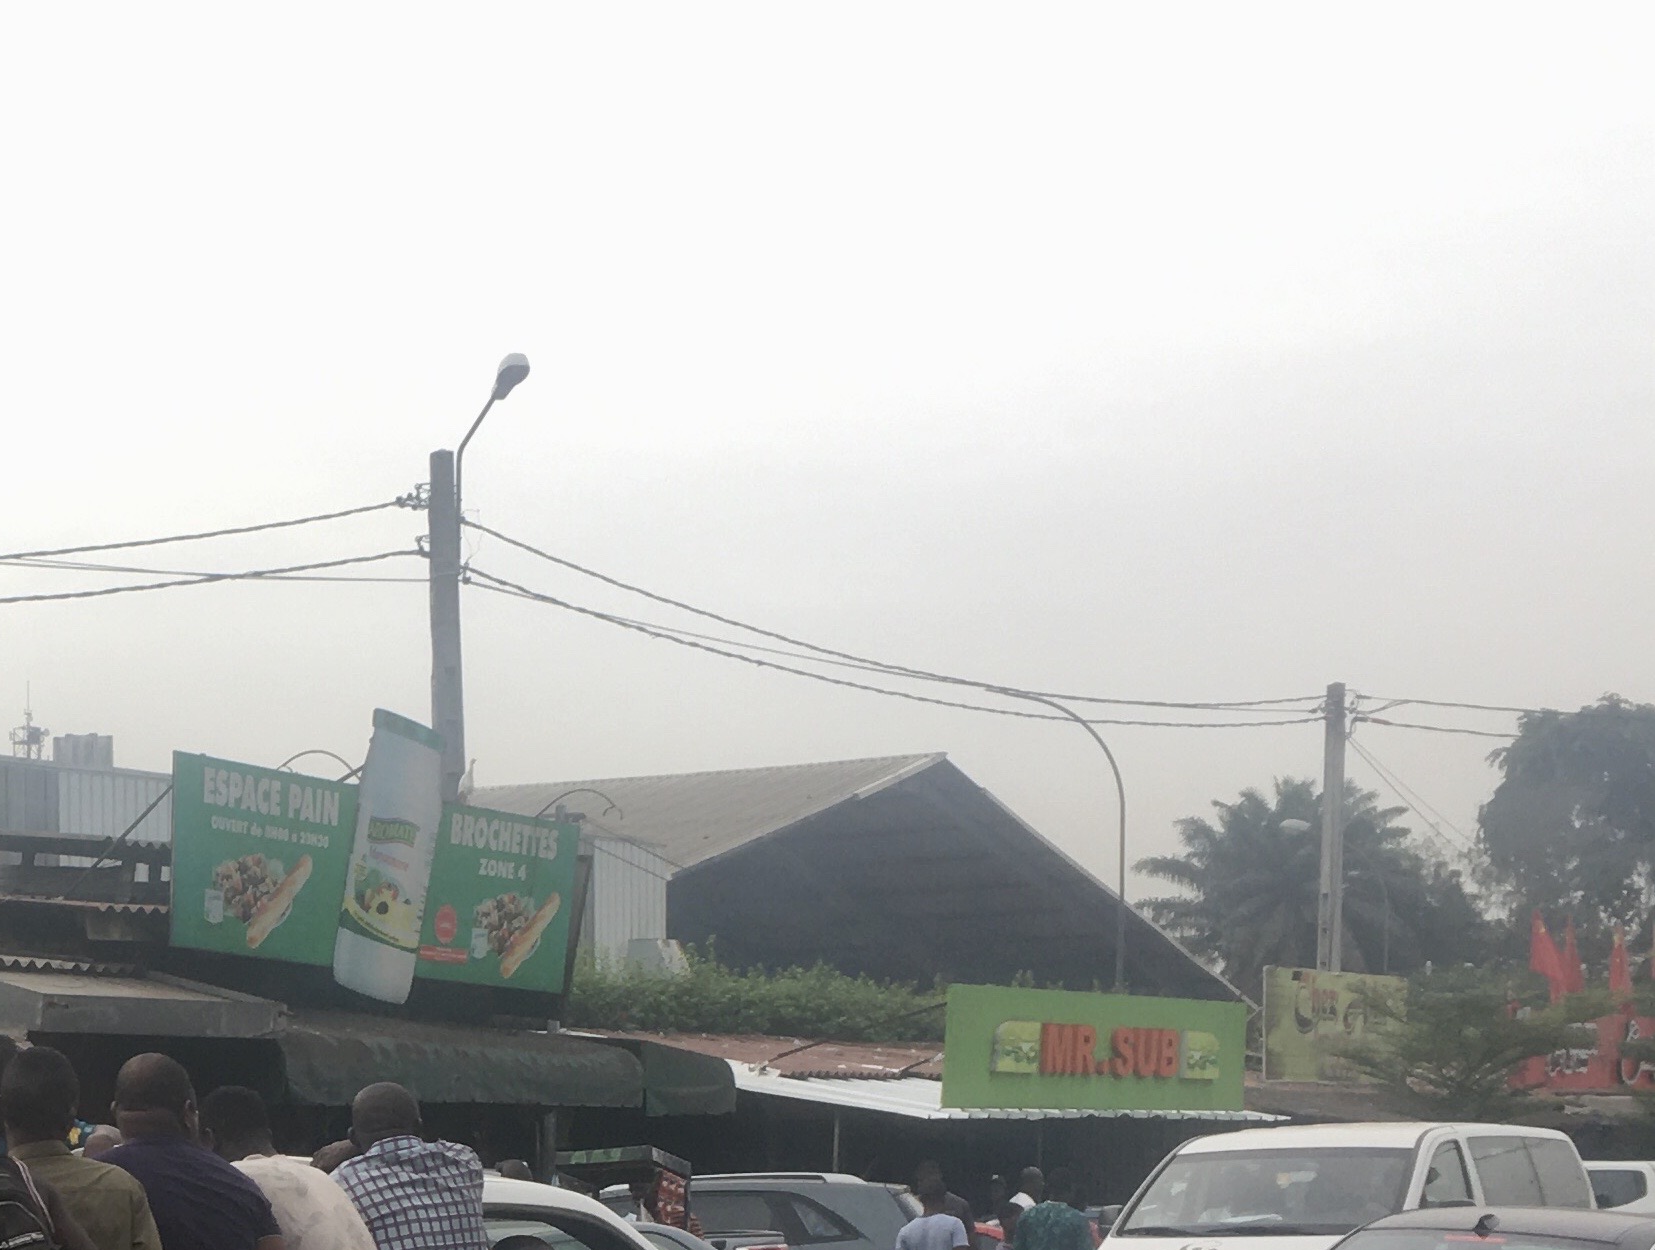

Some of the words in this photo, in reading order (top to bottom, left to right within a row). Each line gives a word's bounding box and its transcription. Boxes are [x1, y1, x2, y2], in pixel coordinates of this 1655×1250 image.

[204, 766, 281, 816] ESPACE
[288, 783, 340, 826] PAIN
[451, 813, 559, 860] BROCHETTES
[478, 858, 515, 879] ZONE
[517, 864, 527, 881] 4
